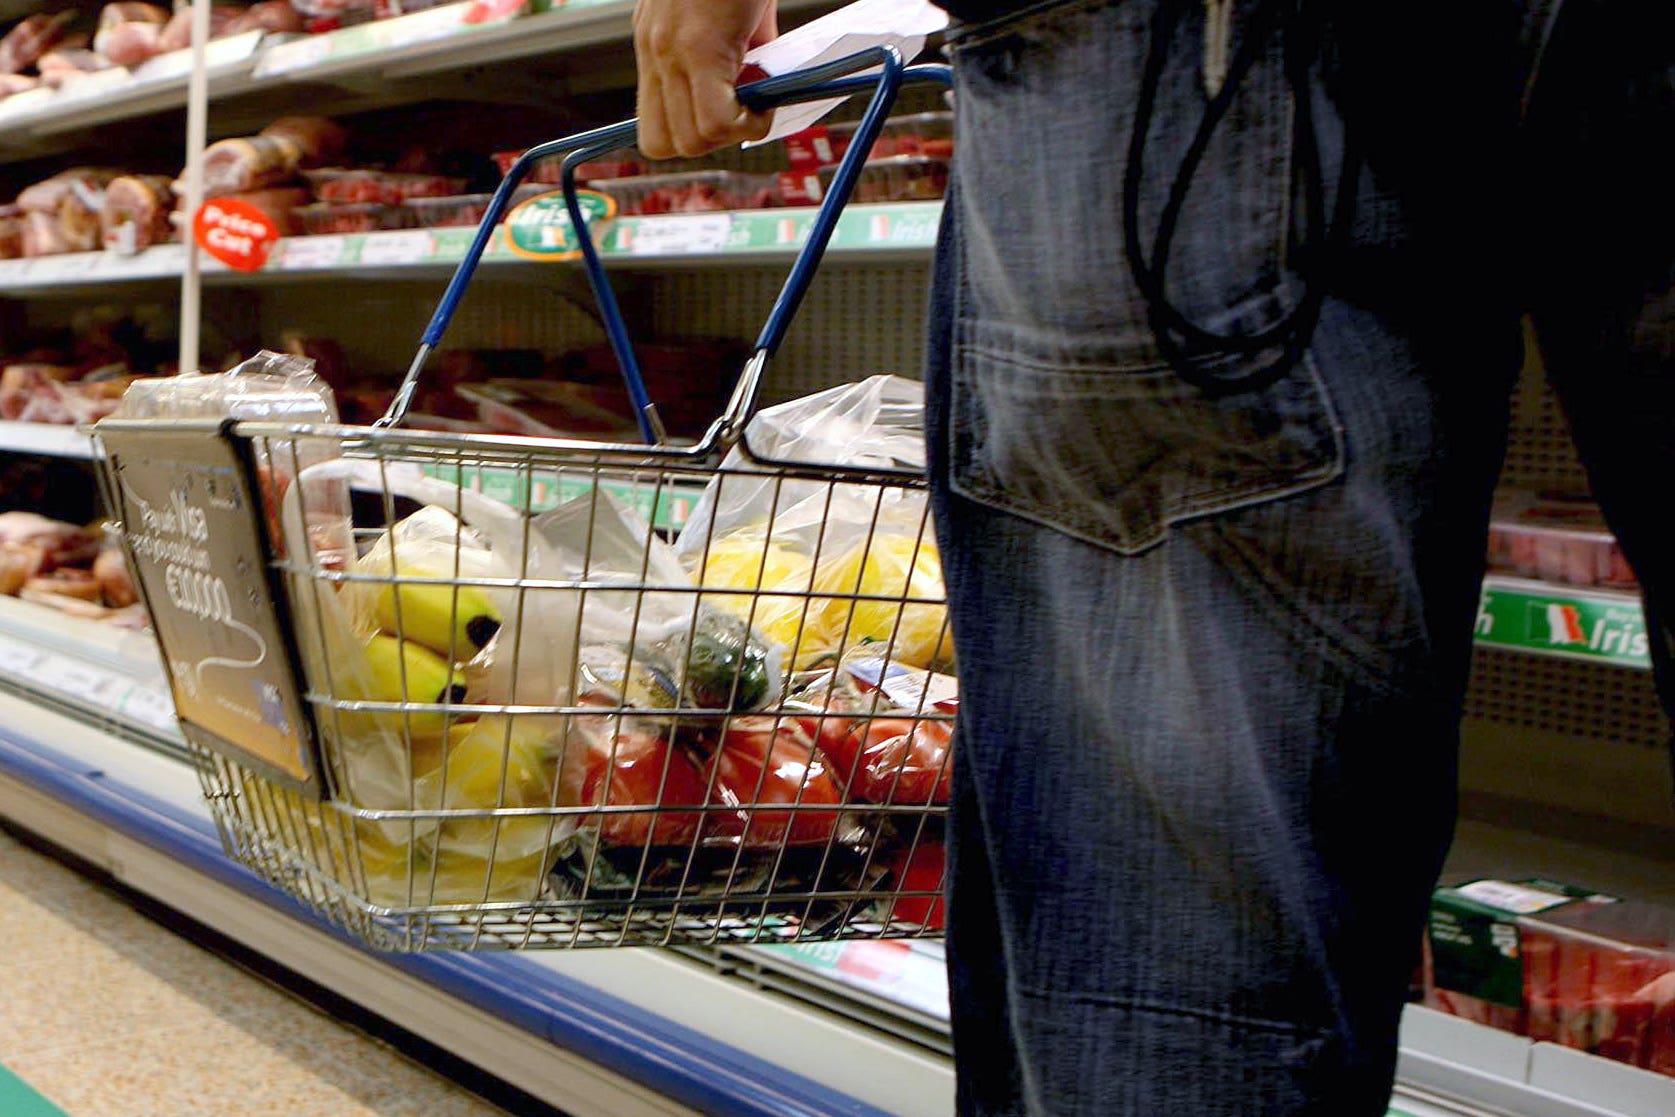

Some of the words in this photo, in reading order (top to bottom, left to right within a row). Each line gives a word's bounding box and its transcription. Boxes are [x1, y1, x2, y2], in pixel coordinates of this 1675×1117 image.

[203, 204, 267, 238] Price
[206, 226, 253, 257] Cut
[1590, 619, 1649, 656] Iris
